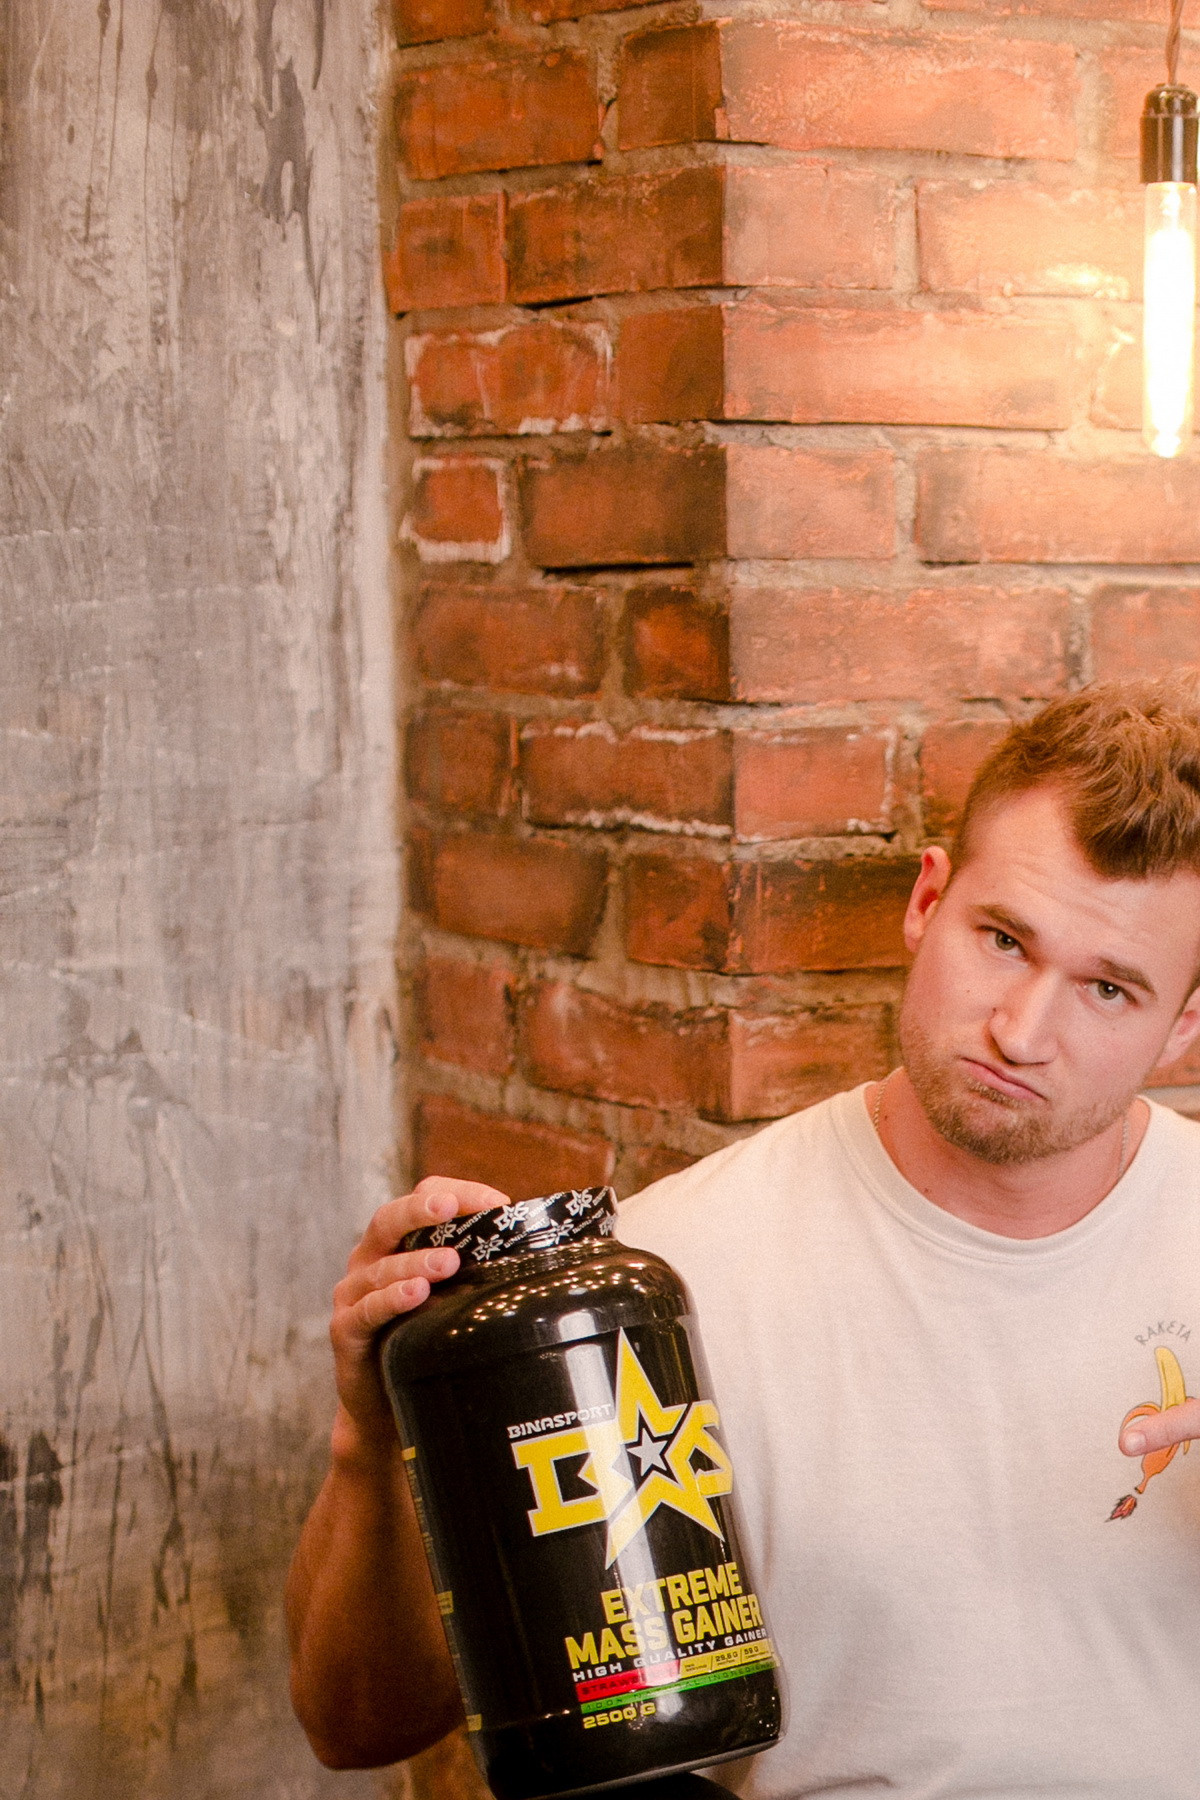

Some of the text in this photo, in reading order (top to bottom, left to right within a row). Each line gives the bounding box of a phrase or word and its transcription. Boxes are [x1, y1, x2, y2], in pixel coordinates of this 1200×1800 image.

[1134, 1320, 1192, 1346] RAKETA
[506, 1403, 612, 1439] BINASPORT
[601, 1562, 743, 1625] EXTREME
[565, 1594, 764, 1669] MASS GAINER
[572, 1628, 767, 1682] HIGH QUALITY GAINER
[582, 1702, 657, 1730] 2500 G
